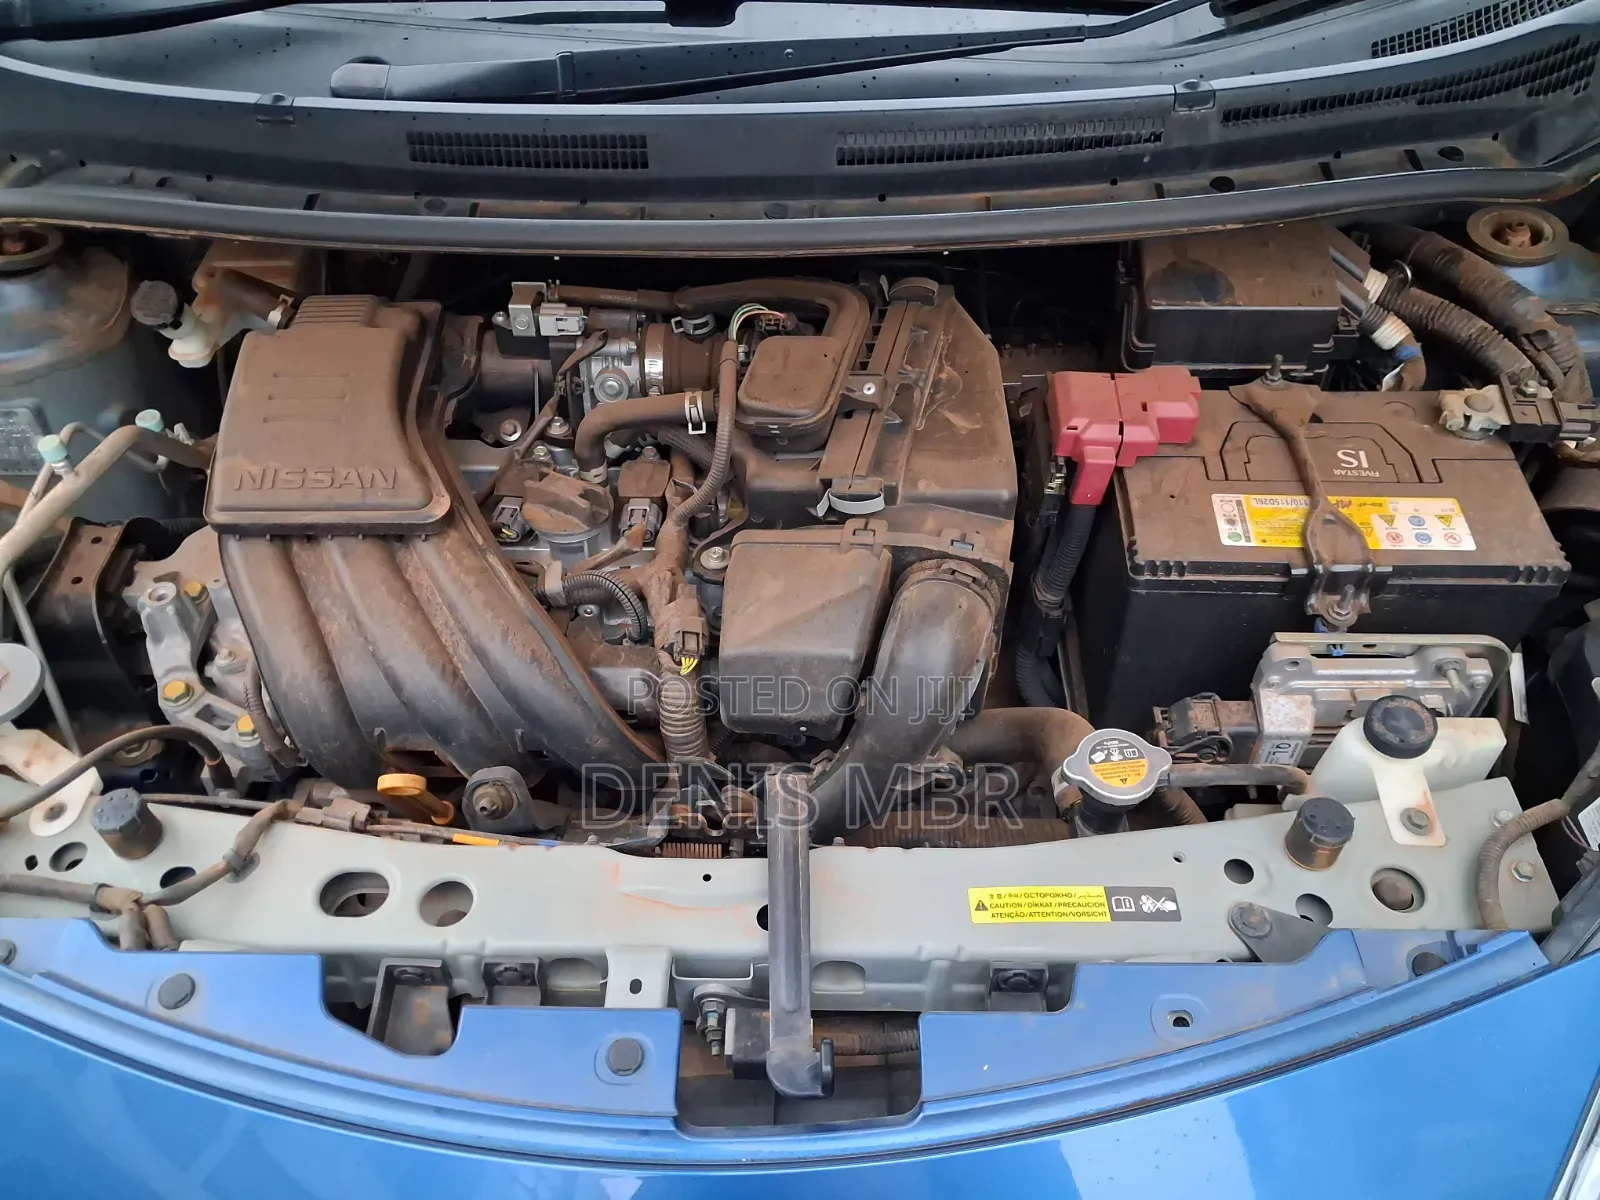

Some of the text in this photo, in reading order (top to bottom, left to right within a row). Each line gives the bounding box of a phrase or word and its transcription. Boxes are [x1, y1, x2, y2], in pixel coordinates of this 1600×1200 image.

[1336, 449, 1369, 469] IS
[233, 466, 399, 490] NISSAN
[1333, 468, 1380, 477] FIVESTAR
